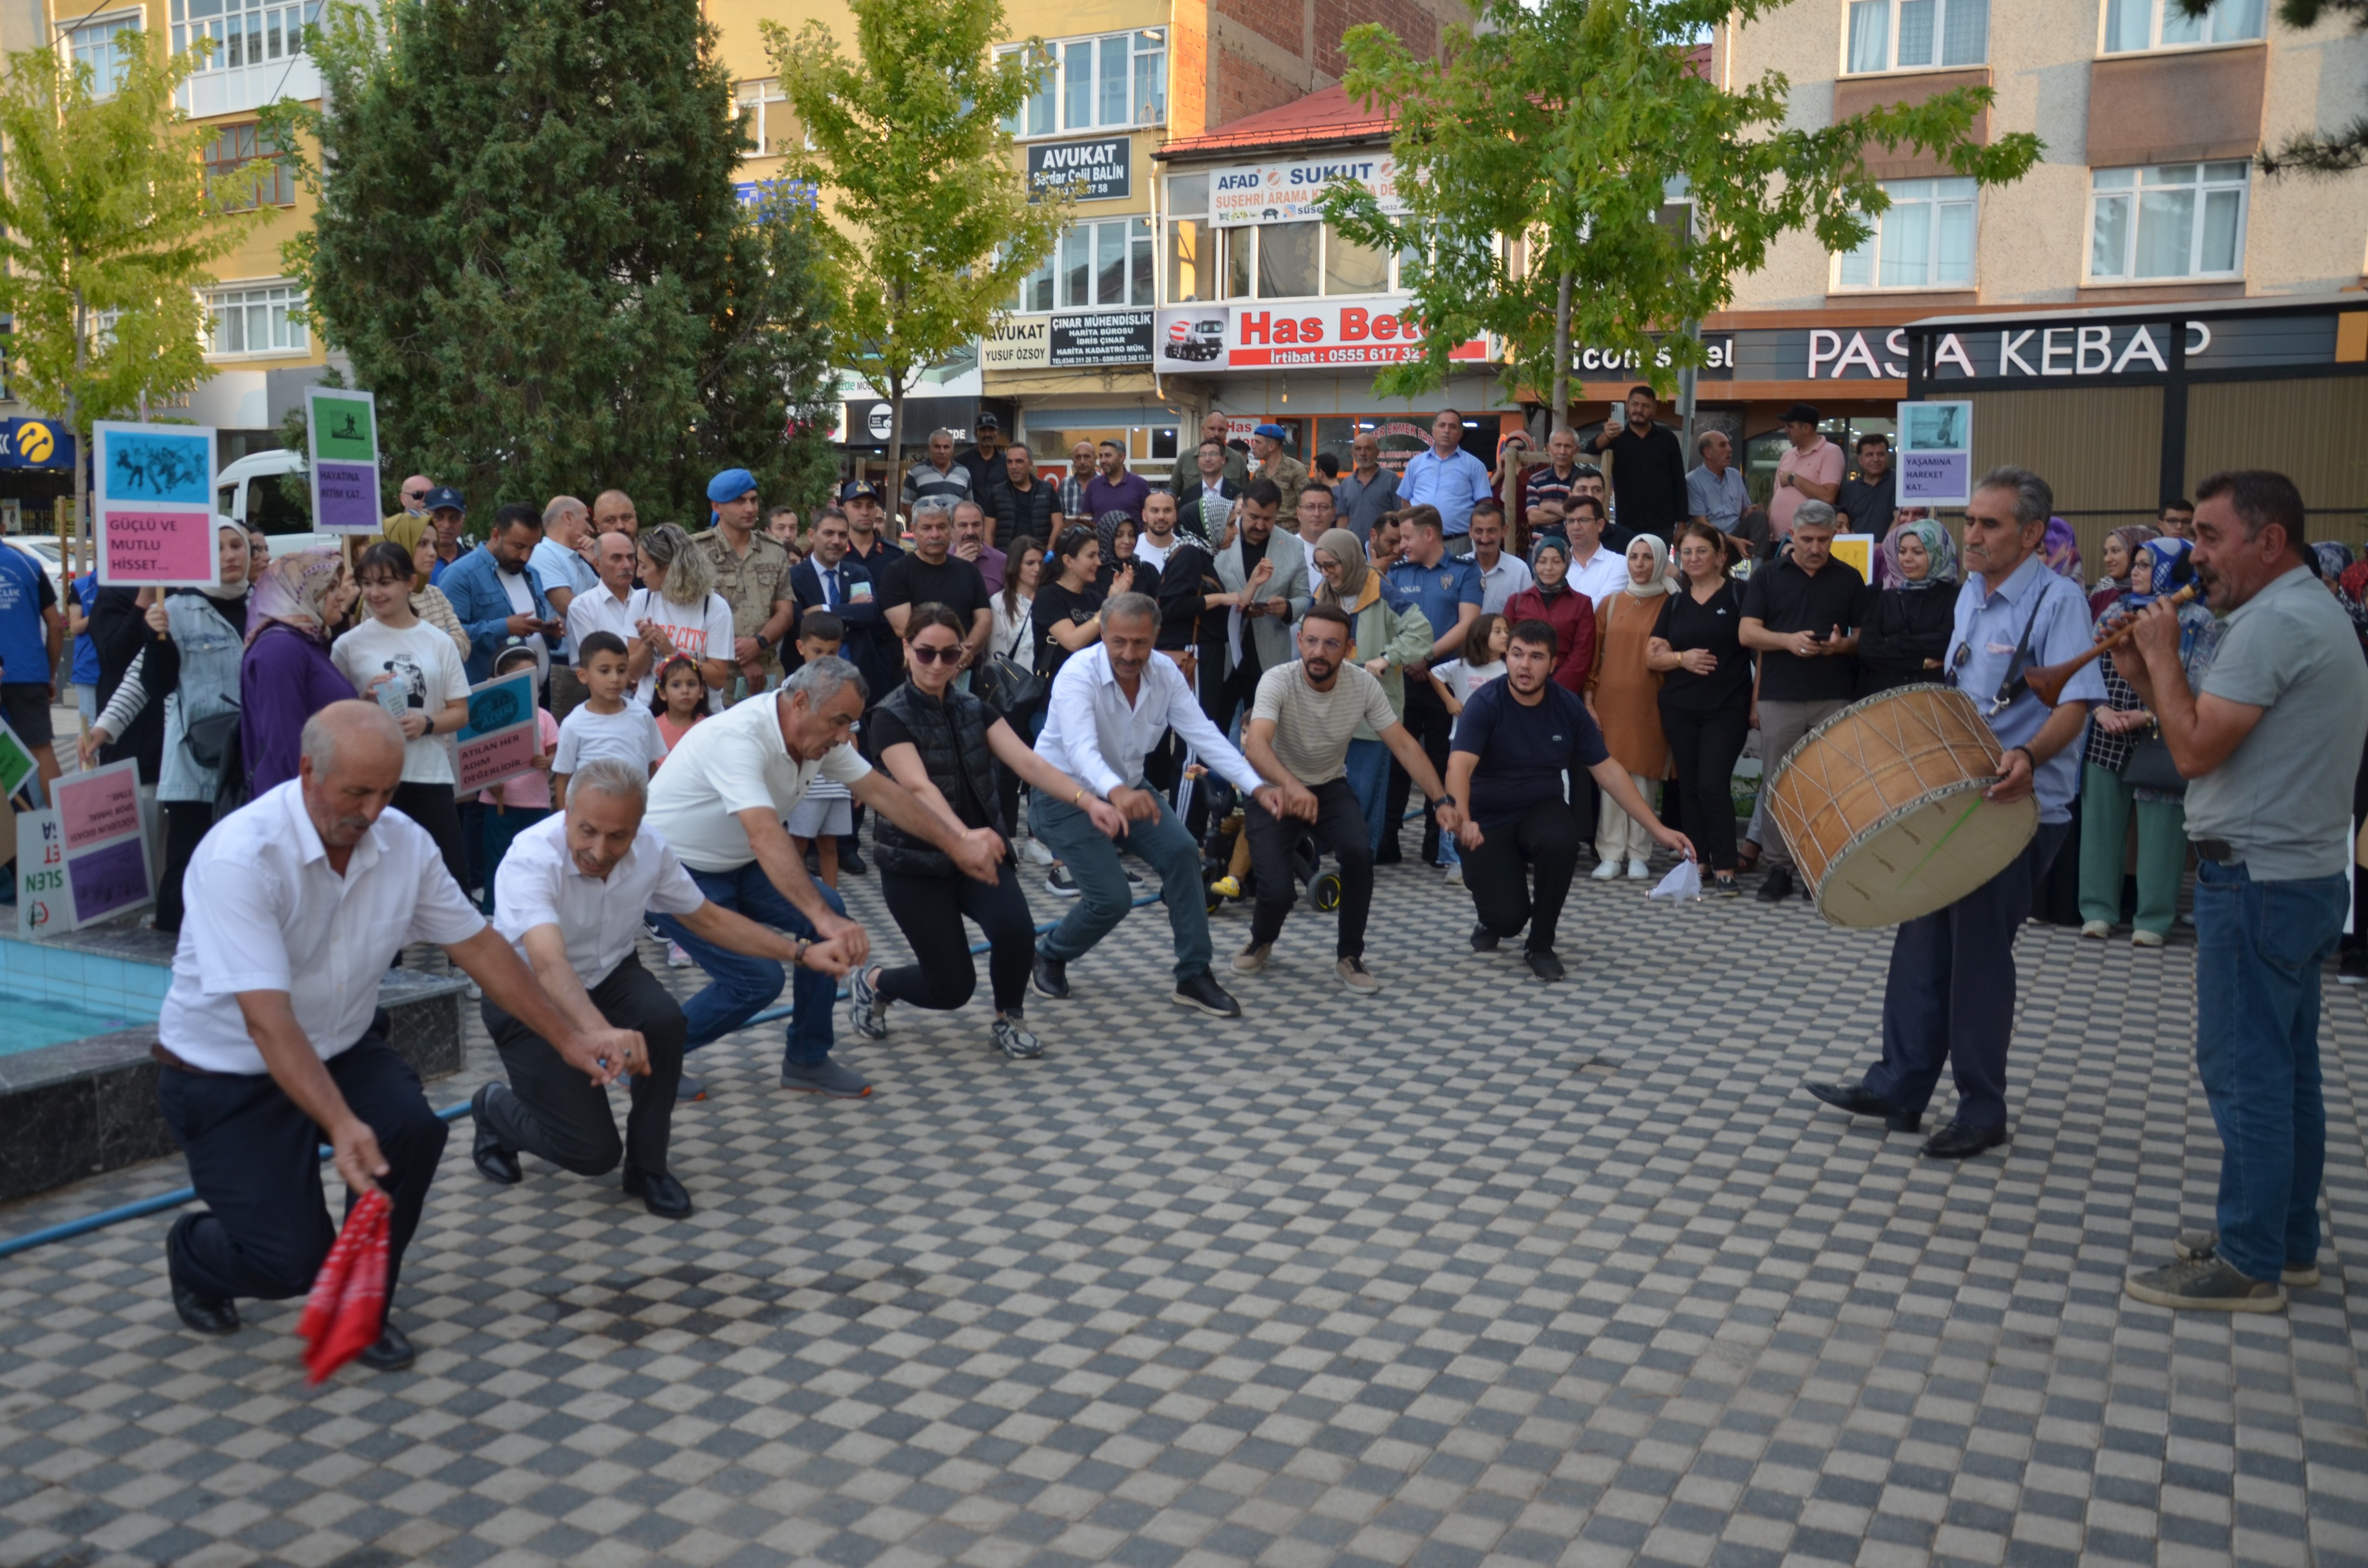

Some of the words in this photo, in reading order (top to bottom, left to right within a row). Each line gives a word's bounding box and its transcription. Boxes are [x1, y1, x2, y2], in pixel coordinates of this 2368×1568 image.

[1042, 144, 1117, 169] AVUKAT
[1093, 162, 1124, 181] BALİN
[1218, 173, 1259, 190] AFAD
[1290, 162, 1373, 184] SUKUT
[1098, 184, 1108, 193] 58
[1216, 190, 1264, 209] SUŞEHRİ
[1268, 189, 1308, 205] ARAMA
[1052, 318, 1082, 331] ÇINAR
[1084, 312, 1151, 328] MÜHENDİSLİK
[1241, 311, 1324, 345] Has
[990, 324, 1045, 341] AVUKAT
[1069, 328, 1098, 337] HARİTA
[1100, 327, 1134, 336] BÜROSU
[1076, 336, 1098, 345] İDRİS
[1100, 337, 1125, 346] ÇINAR
[1999, 321, 2210, 376] KEBAP
[986, 349, 1013, 361] YUSUF
[1016, 346, 1045, 360] ÖZSOY
[1057, 347, 1083, 355] HARİTA
[1085, 346, 1125, 355] KADASTRO
[1127, 344, 1146, 352] MÜH.
[1270, 348, 1316, 364] İrtibat
[1328, 349, 1365, 362] 0555
[1369, 347, 1397, 360] 617
[1402, 347, 1420, 359] 32
[1227, 421, 1252, 432] Has
[1387, 422, 1417, 438] EKMEK
[1907, 458, 1951, 467] YAŞAMINA
[320, 471, 360, 482] HAYATINA
[110, 517, 156, 533] GÜÇLÜ
[160, 520, 177, 531] VE
[111, 539, 160, 551] MUTLU
[112, 557, 169, 570] HİSSET...
[676, 626, 707, 653] CITY
[461, 742, 497, 760] ATILAN
[500, 734, 519, 746] HER
[462, 756, 491, 772] ADIM
